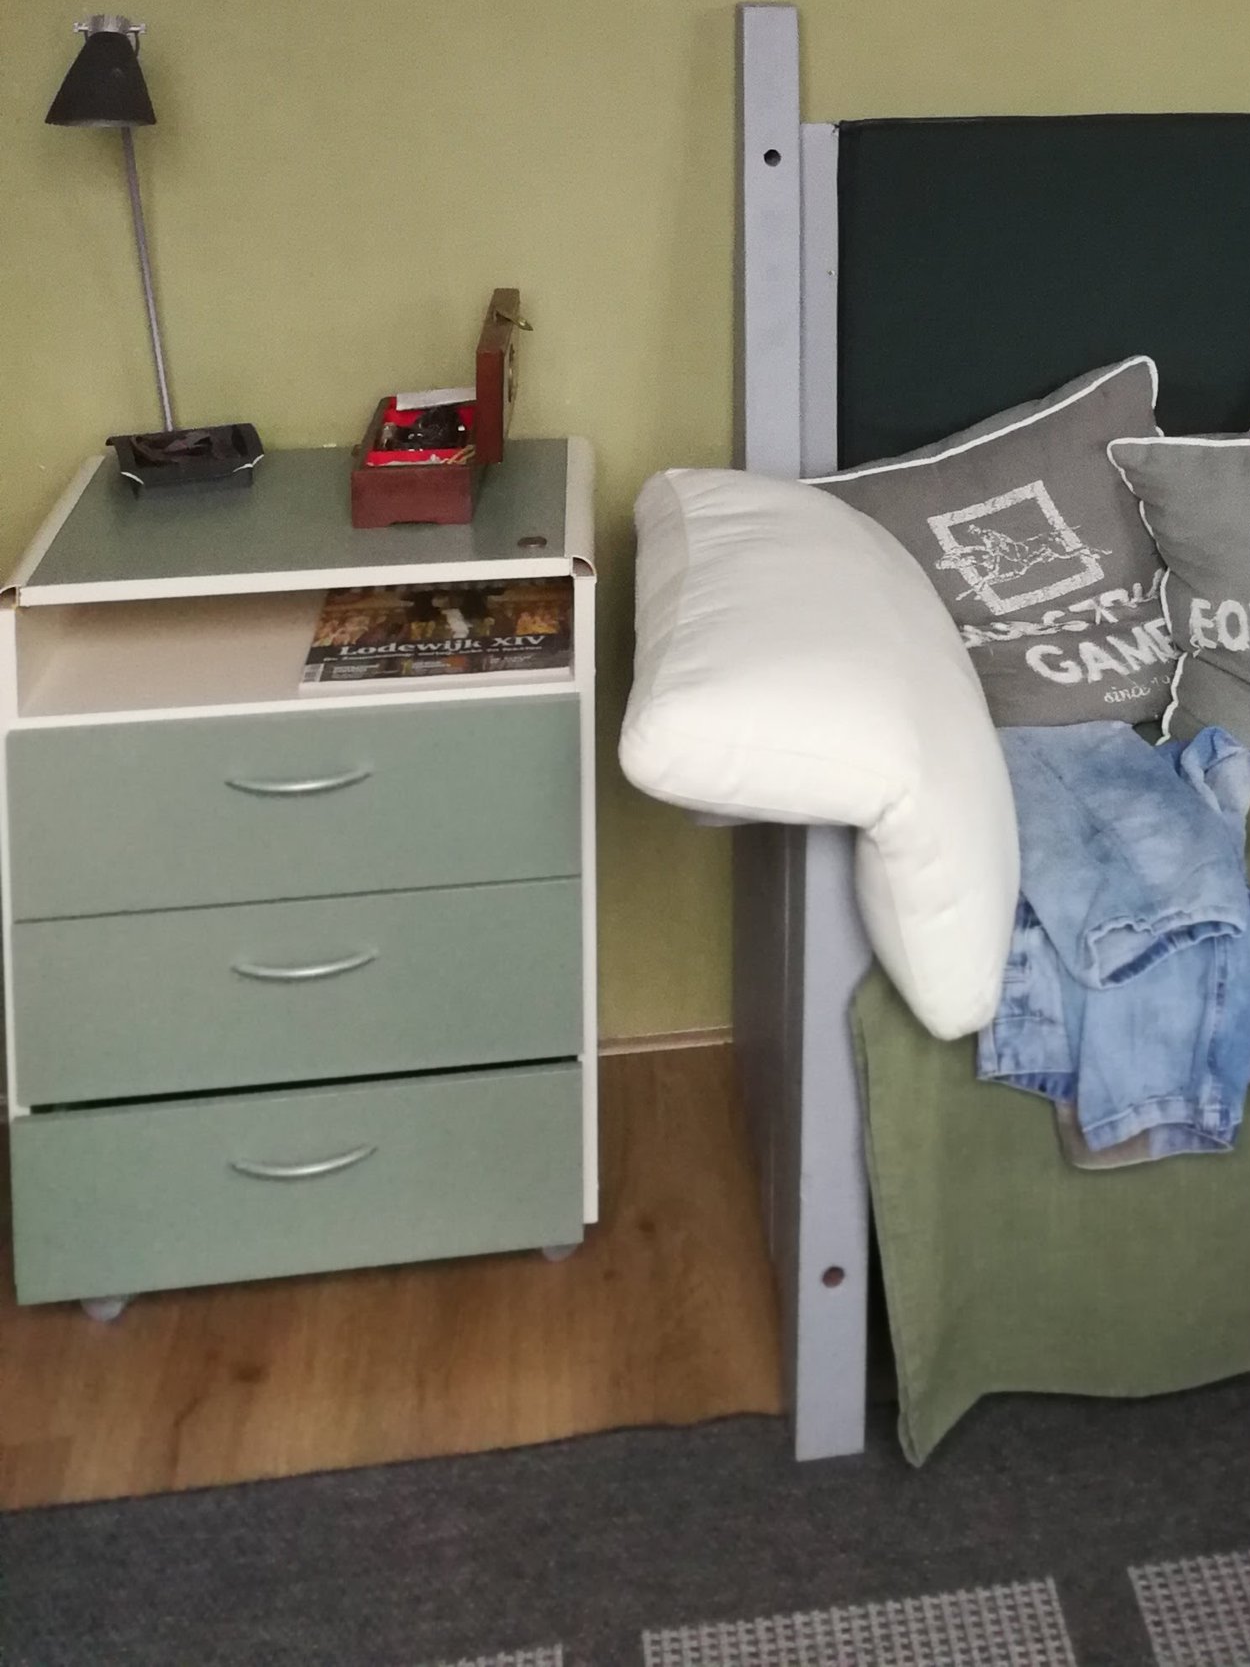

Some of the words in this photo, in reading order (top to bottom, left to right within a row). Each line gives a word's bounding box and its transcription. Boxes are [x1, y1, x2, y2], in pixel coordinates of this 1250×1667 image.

[338, 638, 481, 656] Lodewijk
[490, 635, 546, 647] XIV
[1025, 617, 1182, 684] GAME
